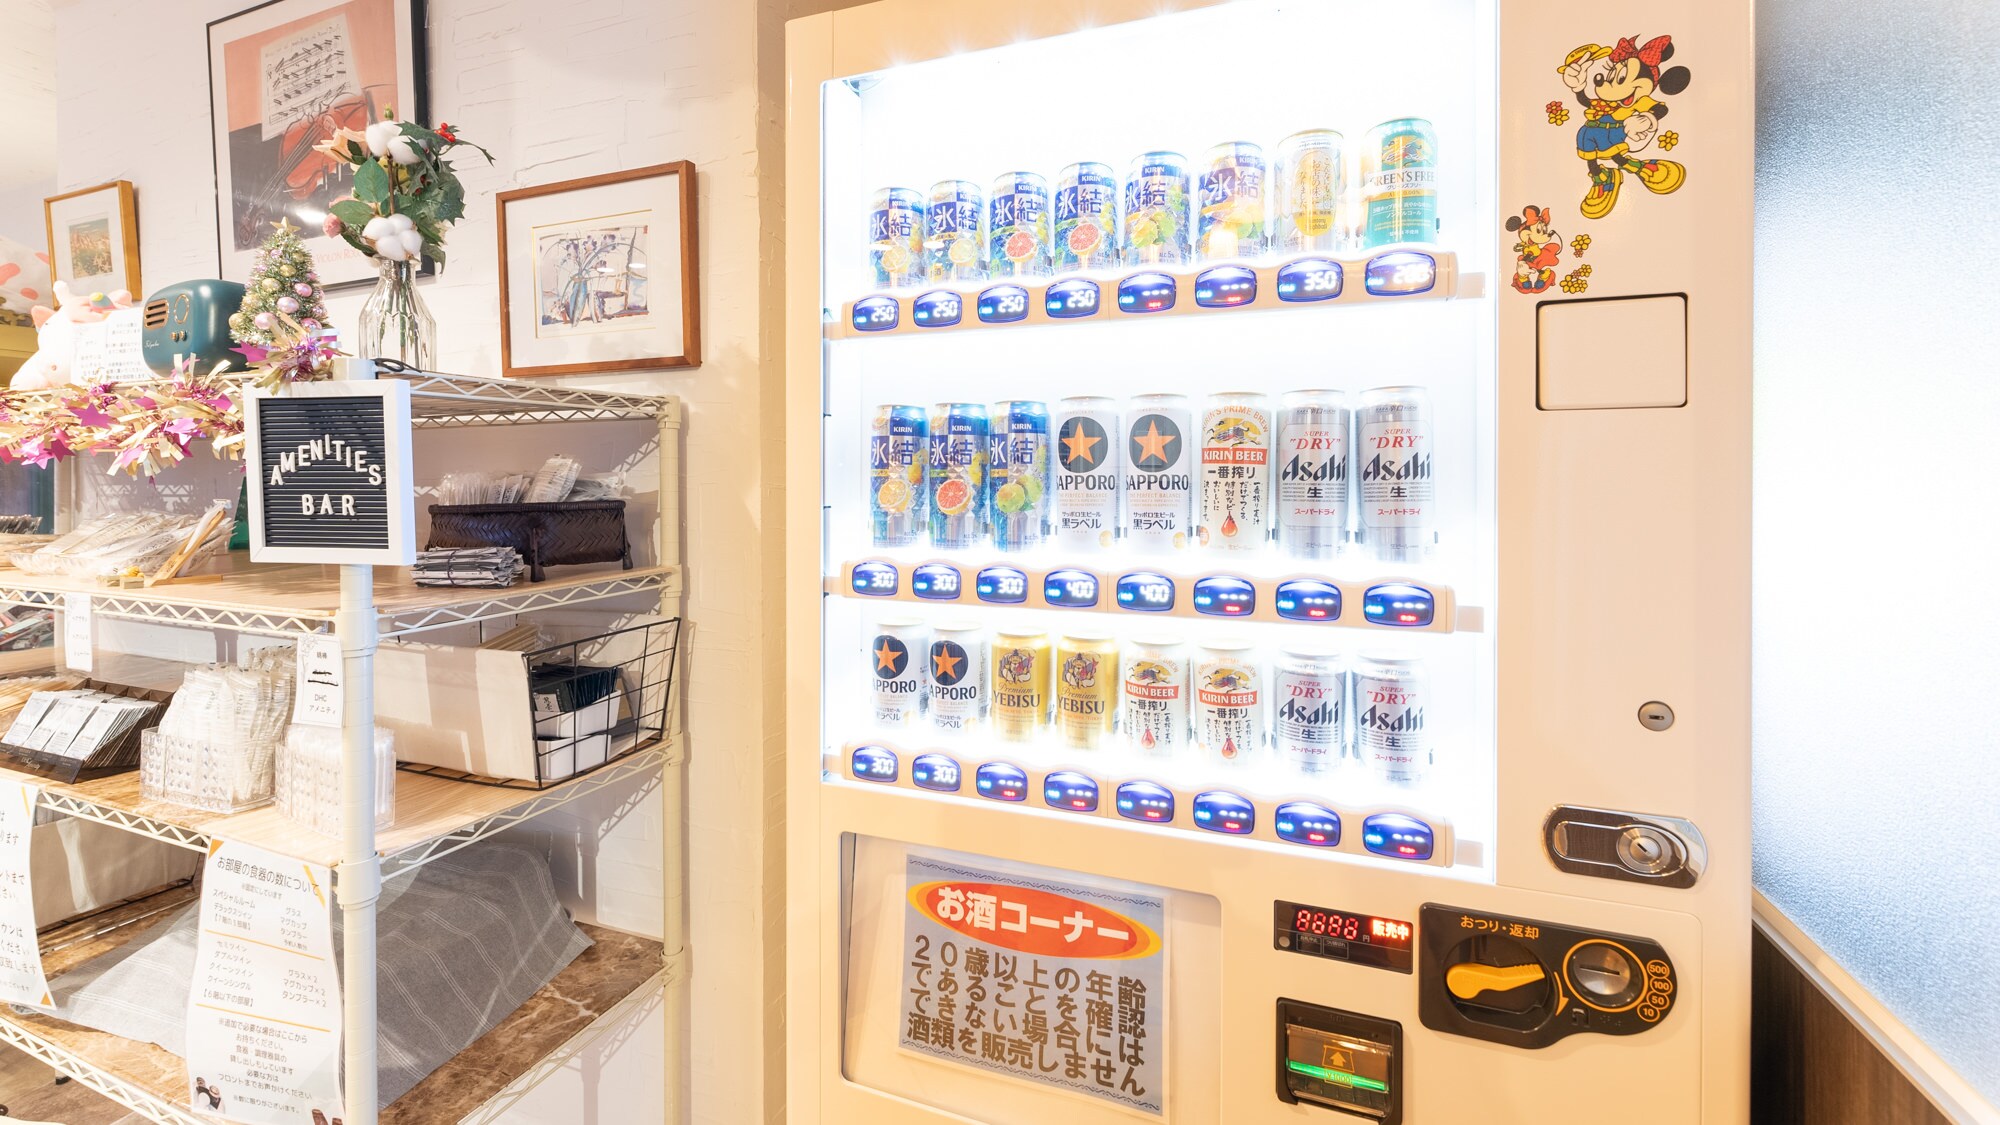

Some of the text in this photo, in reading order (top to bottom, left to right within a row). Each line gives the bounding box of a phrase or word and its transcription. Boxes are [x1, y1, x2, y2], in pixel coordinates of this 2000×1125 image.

[1081, 174, 1101, 182] KIRIN
[1144, 166, 1165, 174] KIRIN
[1414, 169, 1435, 183] FREE
[1208, 172, 1259, 201] 氷結
[1058, 188, 1102, 218] 氷結
[1126, 181, 1166, 210] 氷結
[934, 205, 978, 231] 氷結
[995, 197, 1038, 227] 氷結
[871, 211, 912, 241] 氷結
[1304, 271, 1338, 292] 350
[998, 295, 1024, 313] 250
[1067, 289, 1096, 308] 250
[871, 305, 895, 322] 250
[933, 301, 958, 318] 250
[1223, 404, 1252, 416] PRIME
[1253, 411, 1269, 433] BREW
[270, 434, 383, 486] AMENITIES
[872, 439, 914, 466] 氷結
[930, 439, 974, 466] 氷結
[991, 437, 1034, 466] 氷結
[1203, 449, 1264, 462] KIRIN BEER
[1207, 465, 1256, 480] 一番搾り
[1282, 453, 1346, 482] Asahi
[1362, 451, 1431, 482] Asahi
[1306, 486, 1324, 499] 生
[1389, 485, 1408, 498] 生
[301, 493, 357, 516] BAR
[1294, 507, 1336, 516] スーパードライ
[1377, 507, 1422, 516] スーパードライ
[1061, 517, 1102, 529] 黒ラベル
[1133, 518, 1176, 531] 黒ラベル
[871, 572, 895, 588] 300
[932, 575, 957, 592] 300
[997, 578, 1024, 595] 300
[1066, 582, 1095, 599] 400
[1139, 584, 1170, 602] 400
[998, 681, 1034, 694] Premium
[1062, 686, 1098, 700] Premium
[1127, 685, 1175, 697] KIRIN BEER
[1379, 685, 1404, 693] SUPER
[314, 693, 328, 702] DHC
[993, 689, 1041, 708] YEBISU
[1057, 693, 1105, 715] YEBISU
[1130, 699, 1168, 712] 一番搾り
[1201, 692, 1255, 705] KIRIN BEER
[308, 704, 336, 715] アメニティ
[1207, 707, 1249, 719] 一番搾り
[1279, 697, 1339, 726] Asahi
[1360, 704, 1424, 733] Asahi
[1301, 728, 1317, 740] 生
[1384, 735, 1402, 748] 生
[1290, 744, 1328, 756] スーパードライ
[1374, 752, 1414, 763] スーパードライ
[871, 757, 895, 775] 300
[933, 765, 958, 784] 300
[216, 856, 320, 896] お部屋の食器の数について
[212, 888, 256, 909] スペシャルルーム
[286, 907, 302, 917] グラス
[936, 886, 1130, 943] お酒コーナー
[280, 916, 308, 930] マグカップ
[1371, 918, 1410, 941] 販売中
[1460, 915, 1540, 940] おつり・返却
[280, 927, 308, 940] タンブラー
[1362, 934, 1371, 943] 円
[1649, 964, 1668, 975] 500
[282, 978, 327, 997] マグカップ×2
[1653, 980, 1670, 991] 100
[281, 989, 327, 1008] タンブラー×2
[911, 961, 1147, 1039] であることを確認
[1651, 995, 1665, 1005] 50
[1643, 1007, 1655, 1017] 10
[909, 987, 1145, 1067] できない場合には
[907, 1011, 1147, 1097] 酒類を販売しません
[246, 1068, 280, 1084] 必要な方は
[217, 1072, 314, 1100] フロントまでお声かけください
